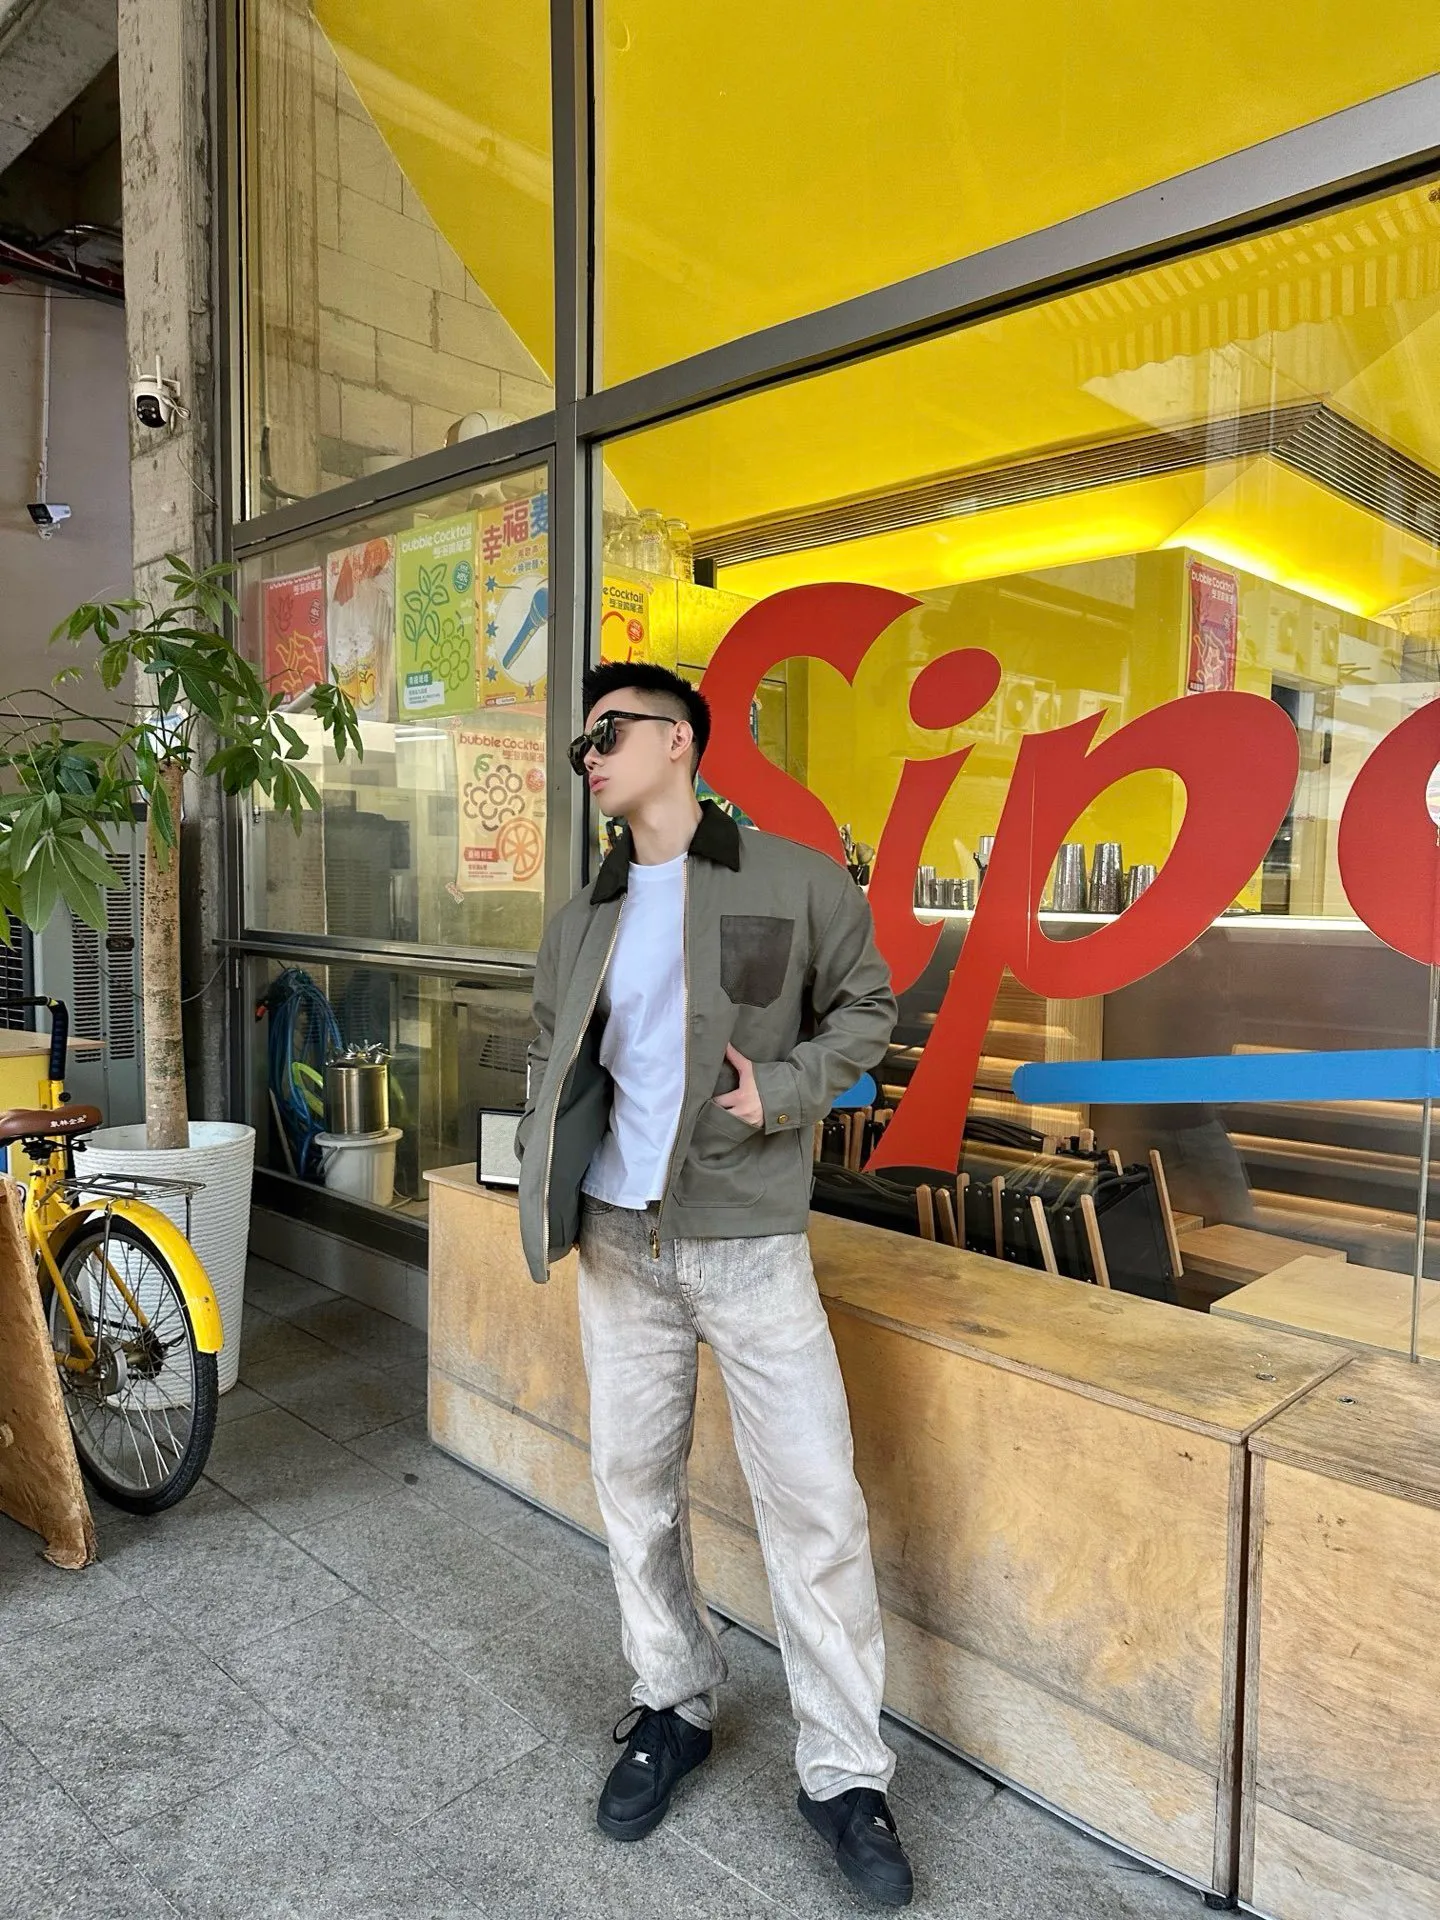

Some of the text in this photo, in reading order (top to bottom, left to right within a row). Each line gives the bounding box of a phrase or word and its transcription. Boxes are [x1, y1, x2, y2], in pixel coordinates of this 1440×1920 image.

[1191, 571, 1212, 585] bubble
[609, 587, 643, 602] Cocktail
[459, 733, 501, 748] bubble
